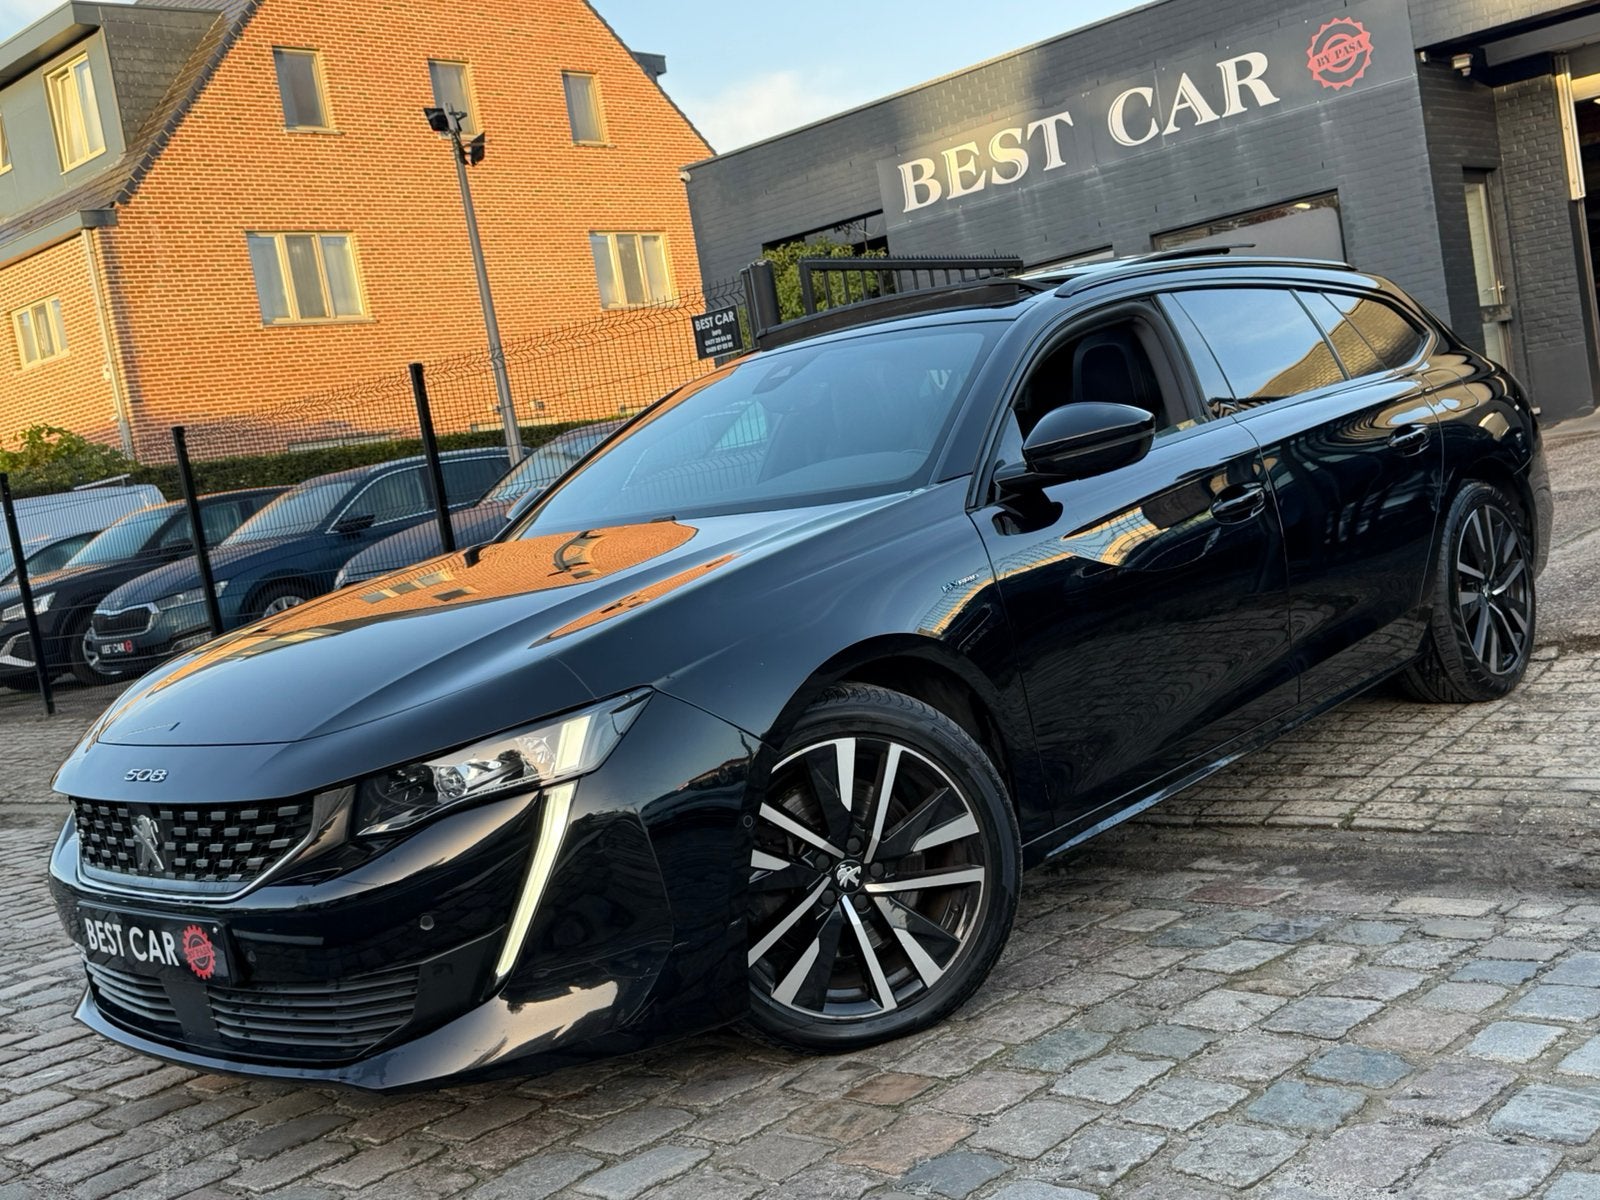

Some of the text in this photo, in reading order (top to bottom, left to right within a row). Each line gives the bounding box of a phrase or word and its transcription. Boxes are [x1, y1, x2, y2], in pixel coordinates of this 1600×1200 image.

[897, 52, 1280, 213] BEST CAR
[694, 311, 735, 331] BEST CAR
[124, 768, 167, 782] 508
[84, 917, 125, 957] BEST
[129, 926, 180, 967] CAR
